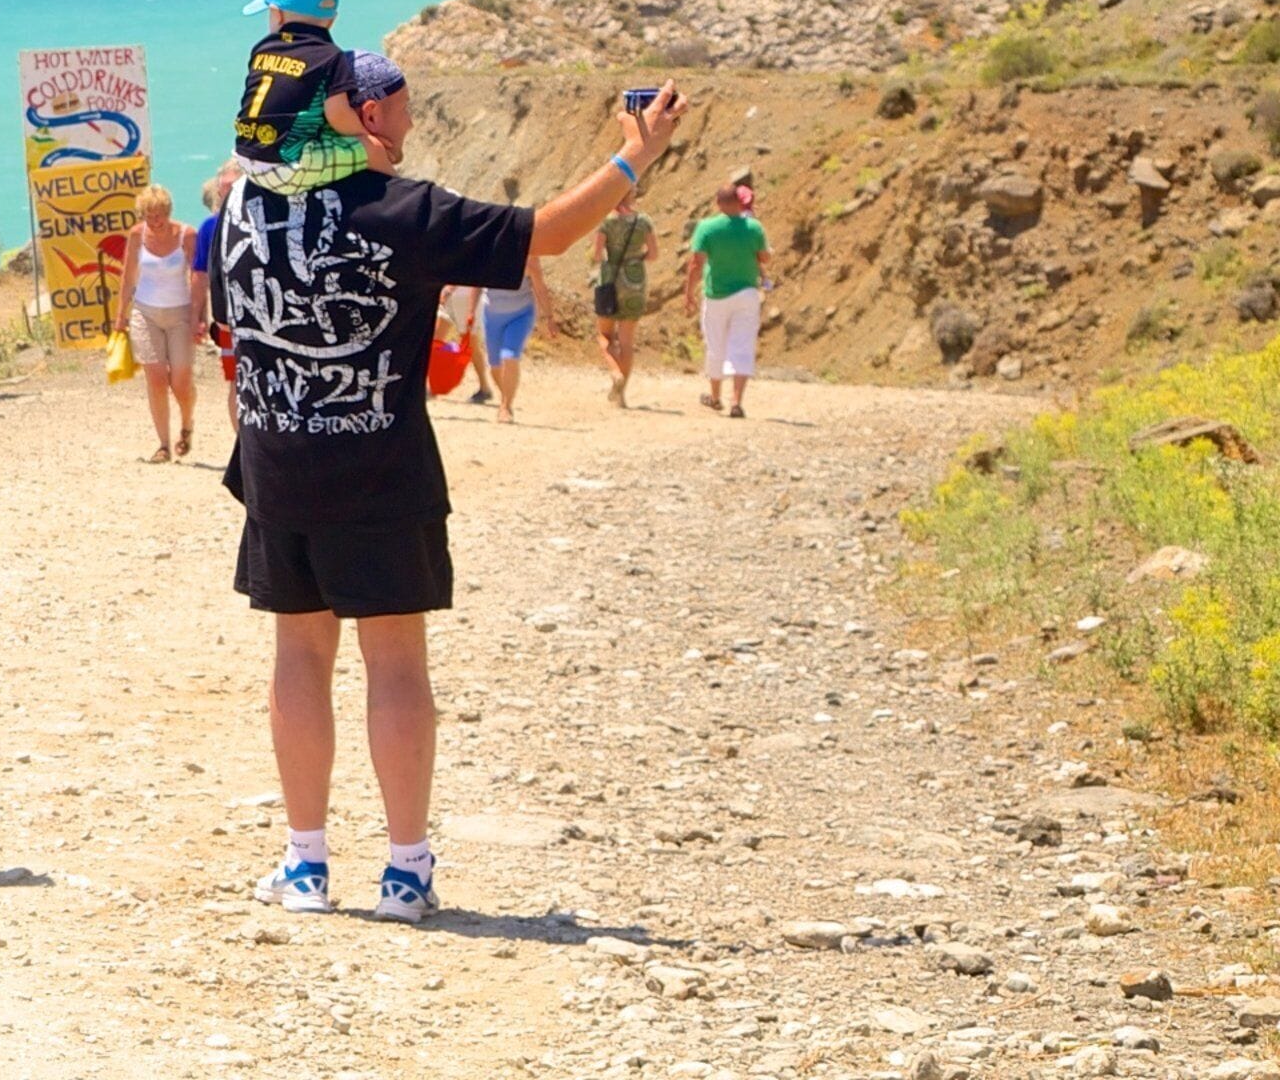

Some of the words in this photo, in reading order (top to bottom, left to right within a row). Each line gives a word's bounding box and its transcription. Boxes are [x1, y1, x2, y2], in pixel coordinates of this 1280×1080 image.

[33, 51, 70, 70] HOT
[76, 48, 135, 66] WATER
[253, 53, 306, 78] V.VALDES
[86, 96, 127, 112] FOOD
[248, 75, 273, 118] 1
[34, 167, 148, 199] WELCOME
